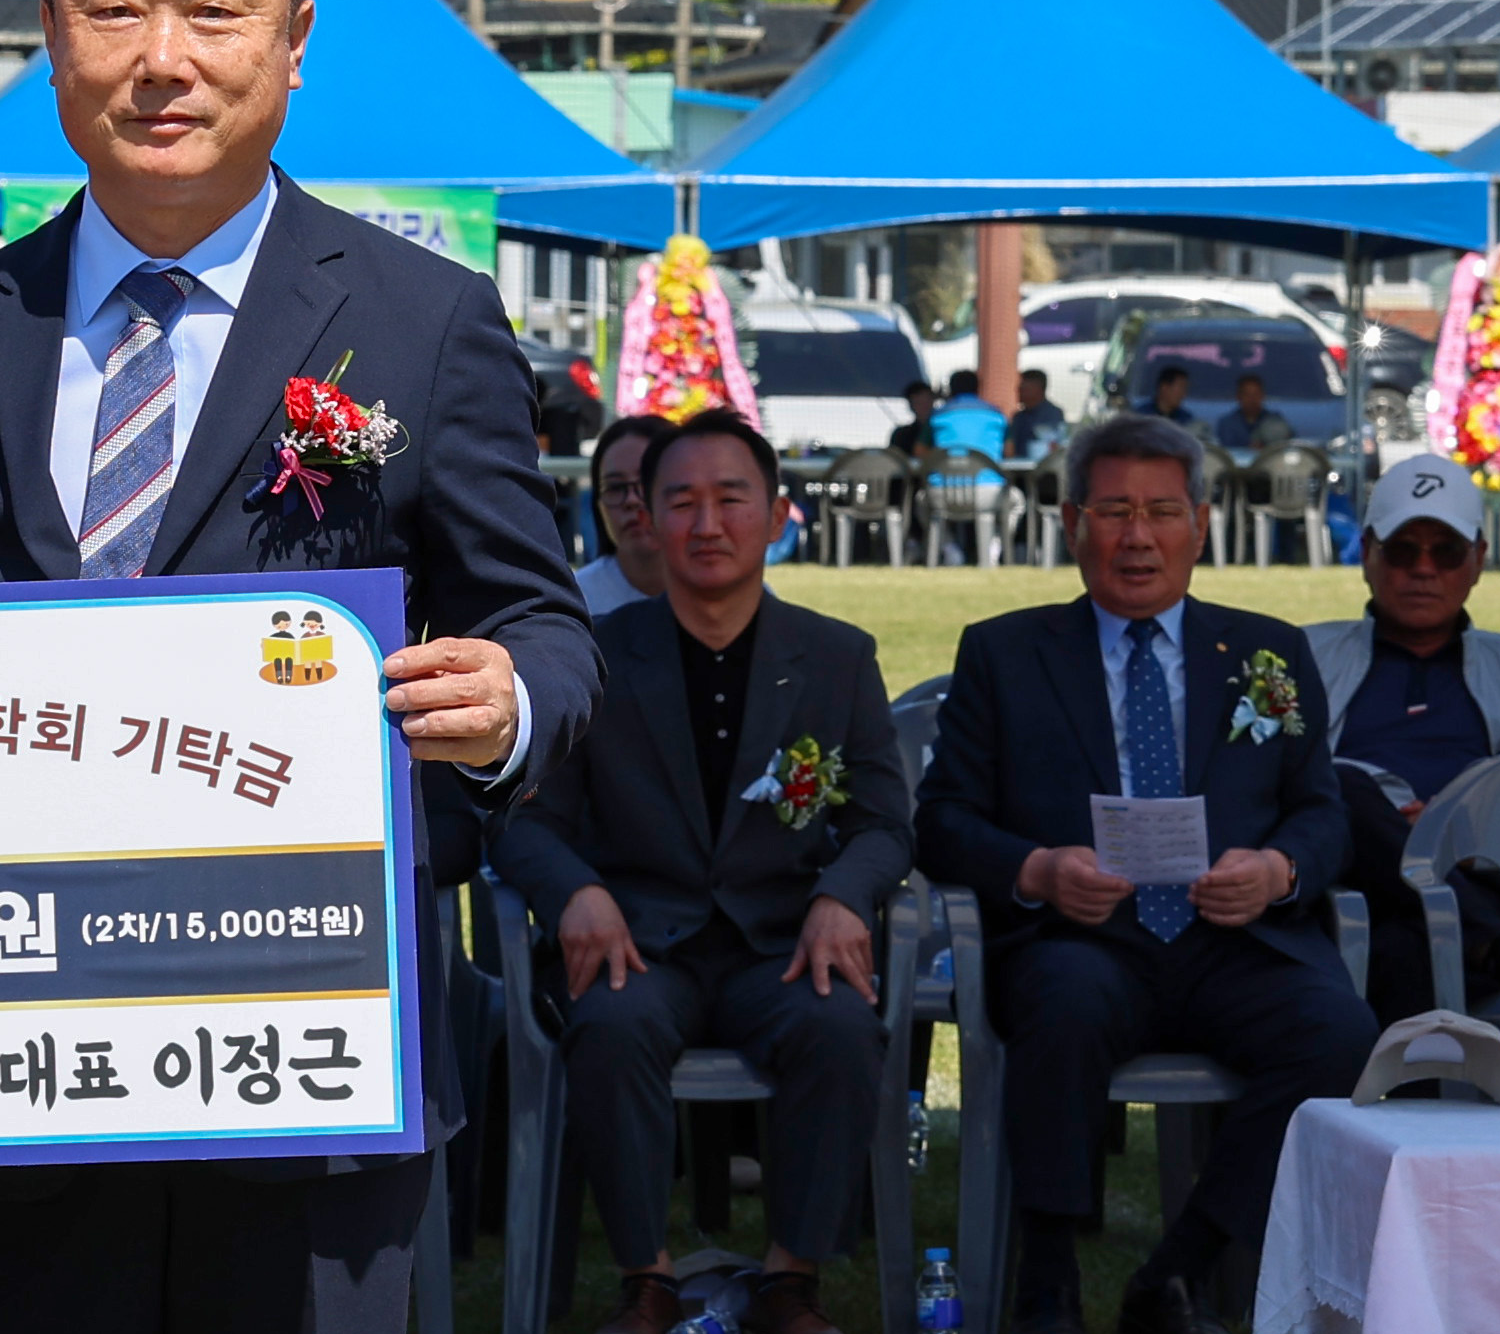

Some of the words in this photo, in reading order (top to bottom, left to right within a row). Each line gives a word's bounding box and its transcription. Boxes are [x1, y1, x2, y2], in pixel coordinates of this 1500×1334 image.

[113, 716, 294, 808] 기탁금
[82, 903, 365, 947] (2차/15,000천원)
[153, 1024, 362, 1106] 이정근
